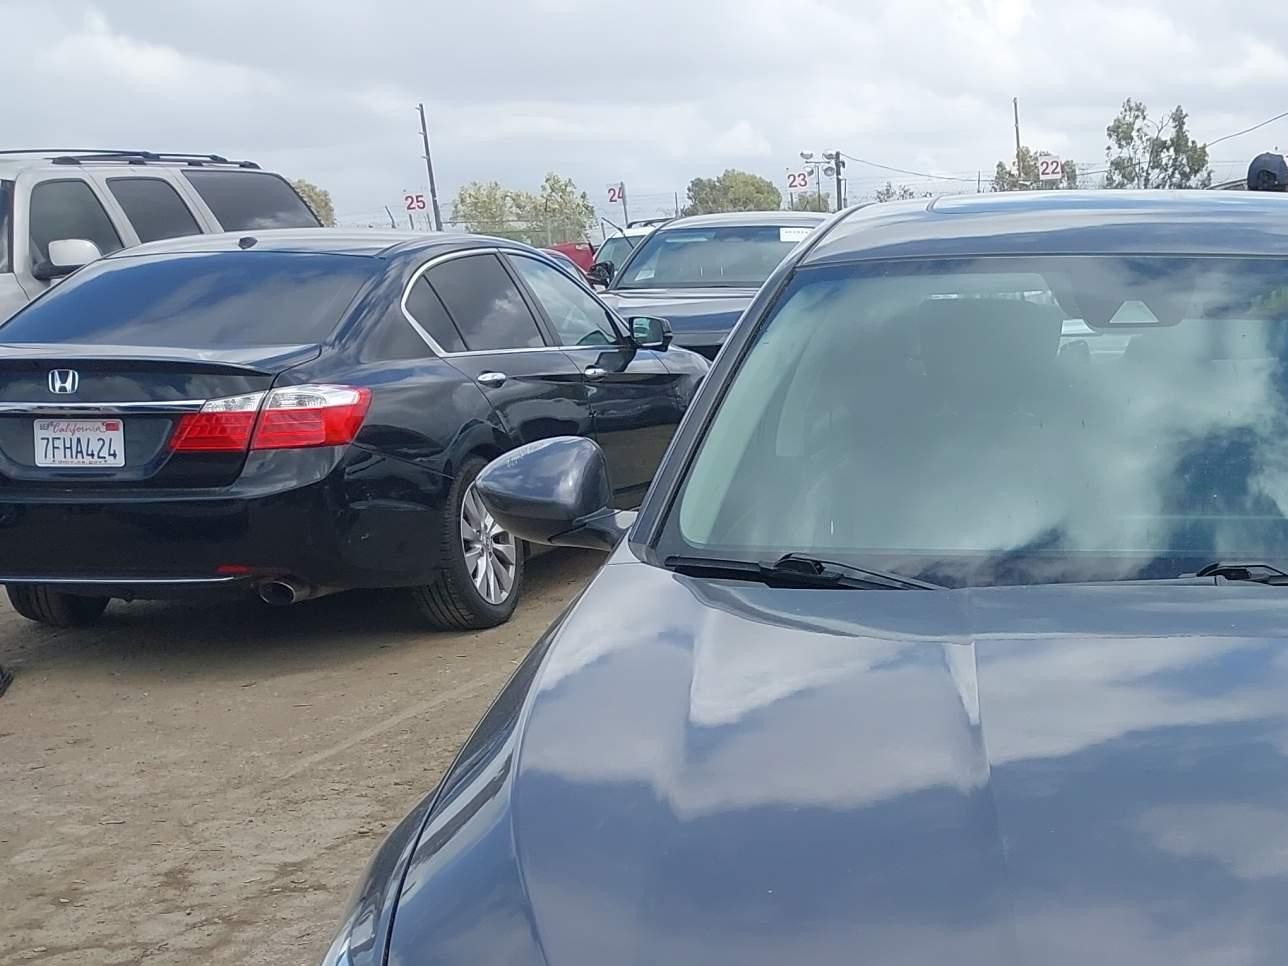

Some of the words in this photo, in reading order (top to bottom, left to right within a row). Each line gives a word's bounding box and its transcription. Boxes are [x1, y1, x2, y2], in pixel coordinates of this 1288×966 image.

[1040, 160, 1060, 175] 22
[787, 173, 808, 188] 23
[607, 186, 624, 202] 24
[404, 195, 426, 210] 25
[51, 422, 106, 436] California
[40, 437, 118, 460] 7FHA424
